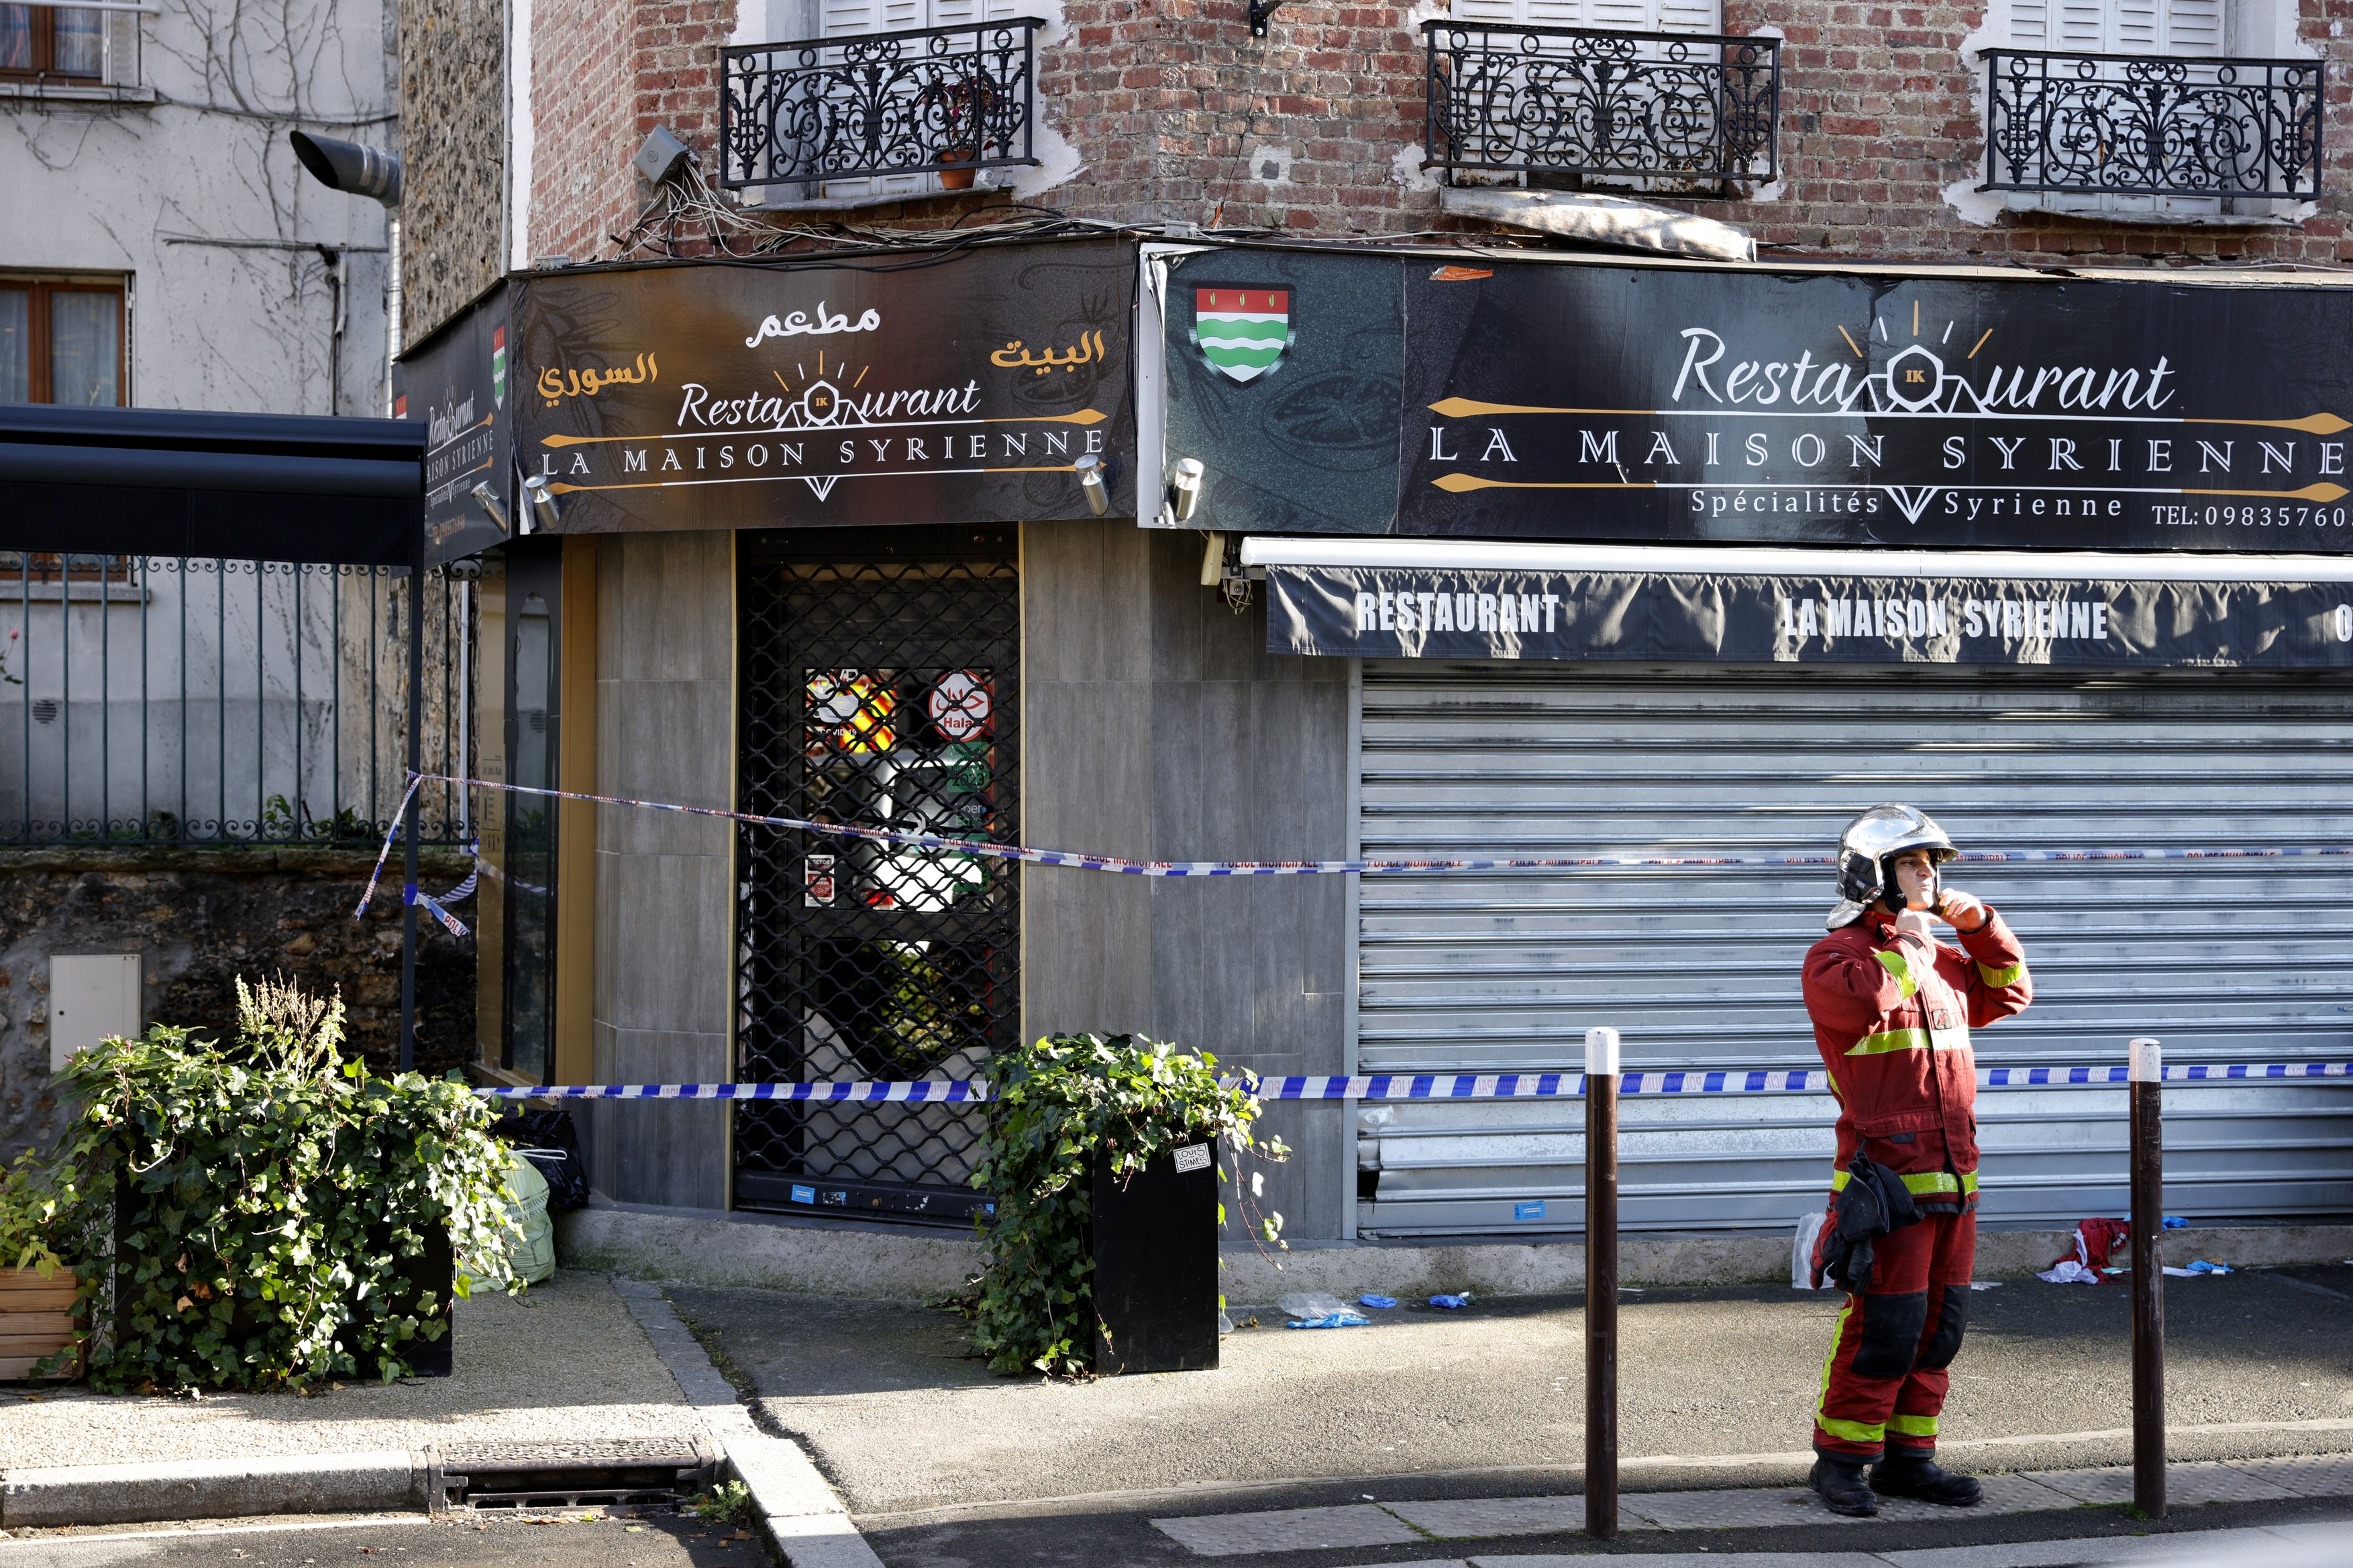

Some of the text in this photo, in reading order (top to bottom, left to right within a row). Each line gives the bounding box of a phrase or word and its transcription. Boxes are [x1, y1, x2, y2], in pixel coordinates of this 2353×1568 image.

[745, 301, 880, 348] مطعم
[990, 329, 1104, 375] البيت
[538, 352, 658, 407] السوري
[1905, 370, 1926, 383] IK
[815, 397, 828, 407] IK
[426, 429, 493, 484] AISON SYRIENNE
[541, 429, 1103, 475] LA MAISON SYRIENNE
[1430, 427, 2344, 475] LA MAISON SYRIENNE
[1691, 490, 2122, 521] Spécialités Syrienne
[2205, 507, 2353, 527] 09835760
[1358, 592, 1559, 633] RESTAURANT
[1784, 598, 2108, 639] LA MAISON SYRIENNE
[943, 717, 979, 728] Hala
